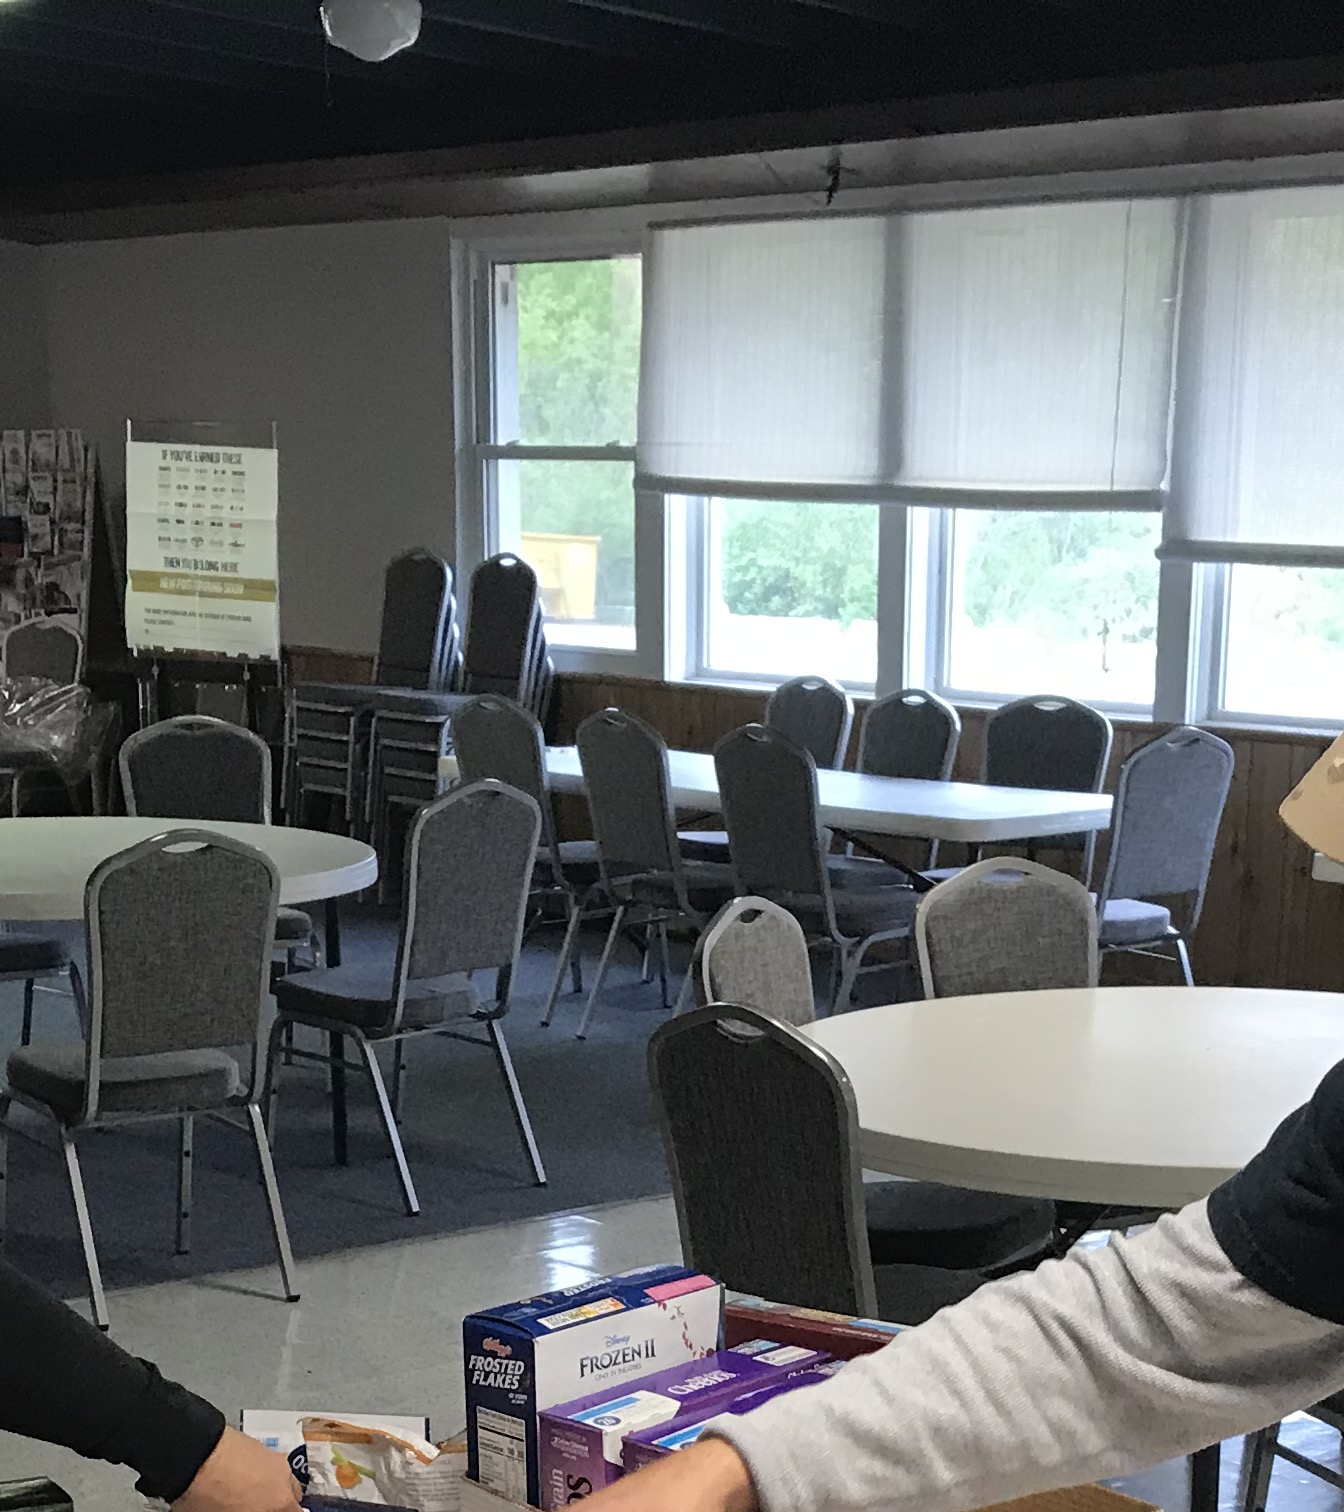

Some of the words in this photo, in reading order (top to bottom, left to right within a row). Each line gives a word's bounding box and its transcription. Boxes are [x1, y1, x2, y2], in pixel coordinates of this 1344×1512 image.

[163, 556, 181, 568] THEN
[603, 1333, 631, 1348] Disney
[468, 1354, 525, 1375] FROSTED
[579, 1343, 642, 1379] FROZEN
[643, 1338, 657, 1359] II
[471, 1371, 521, 1390] FLAKES
